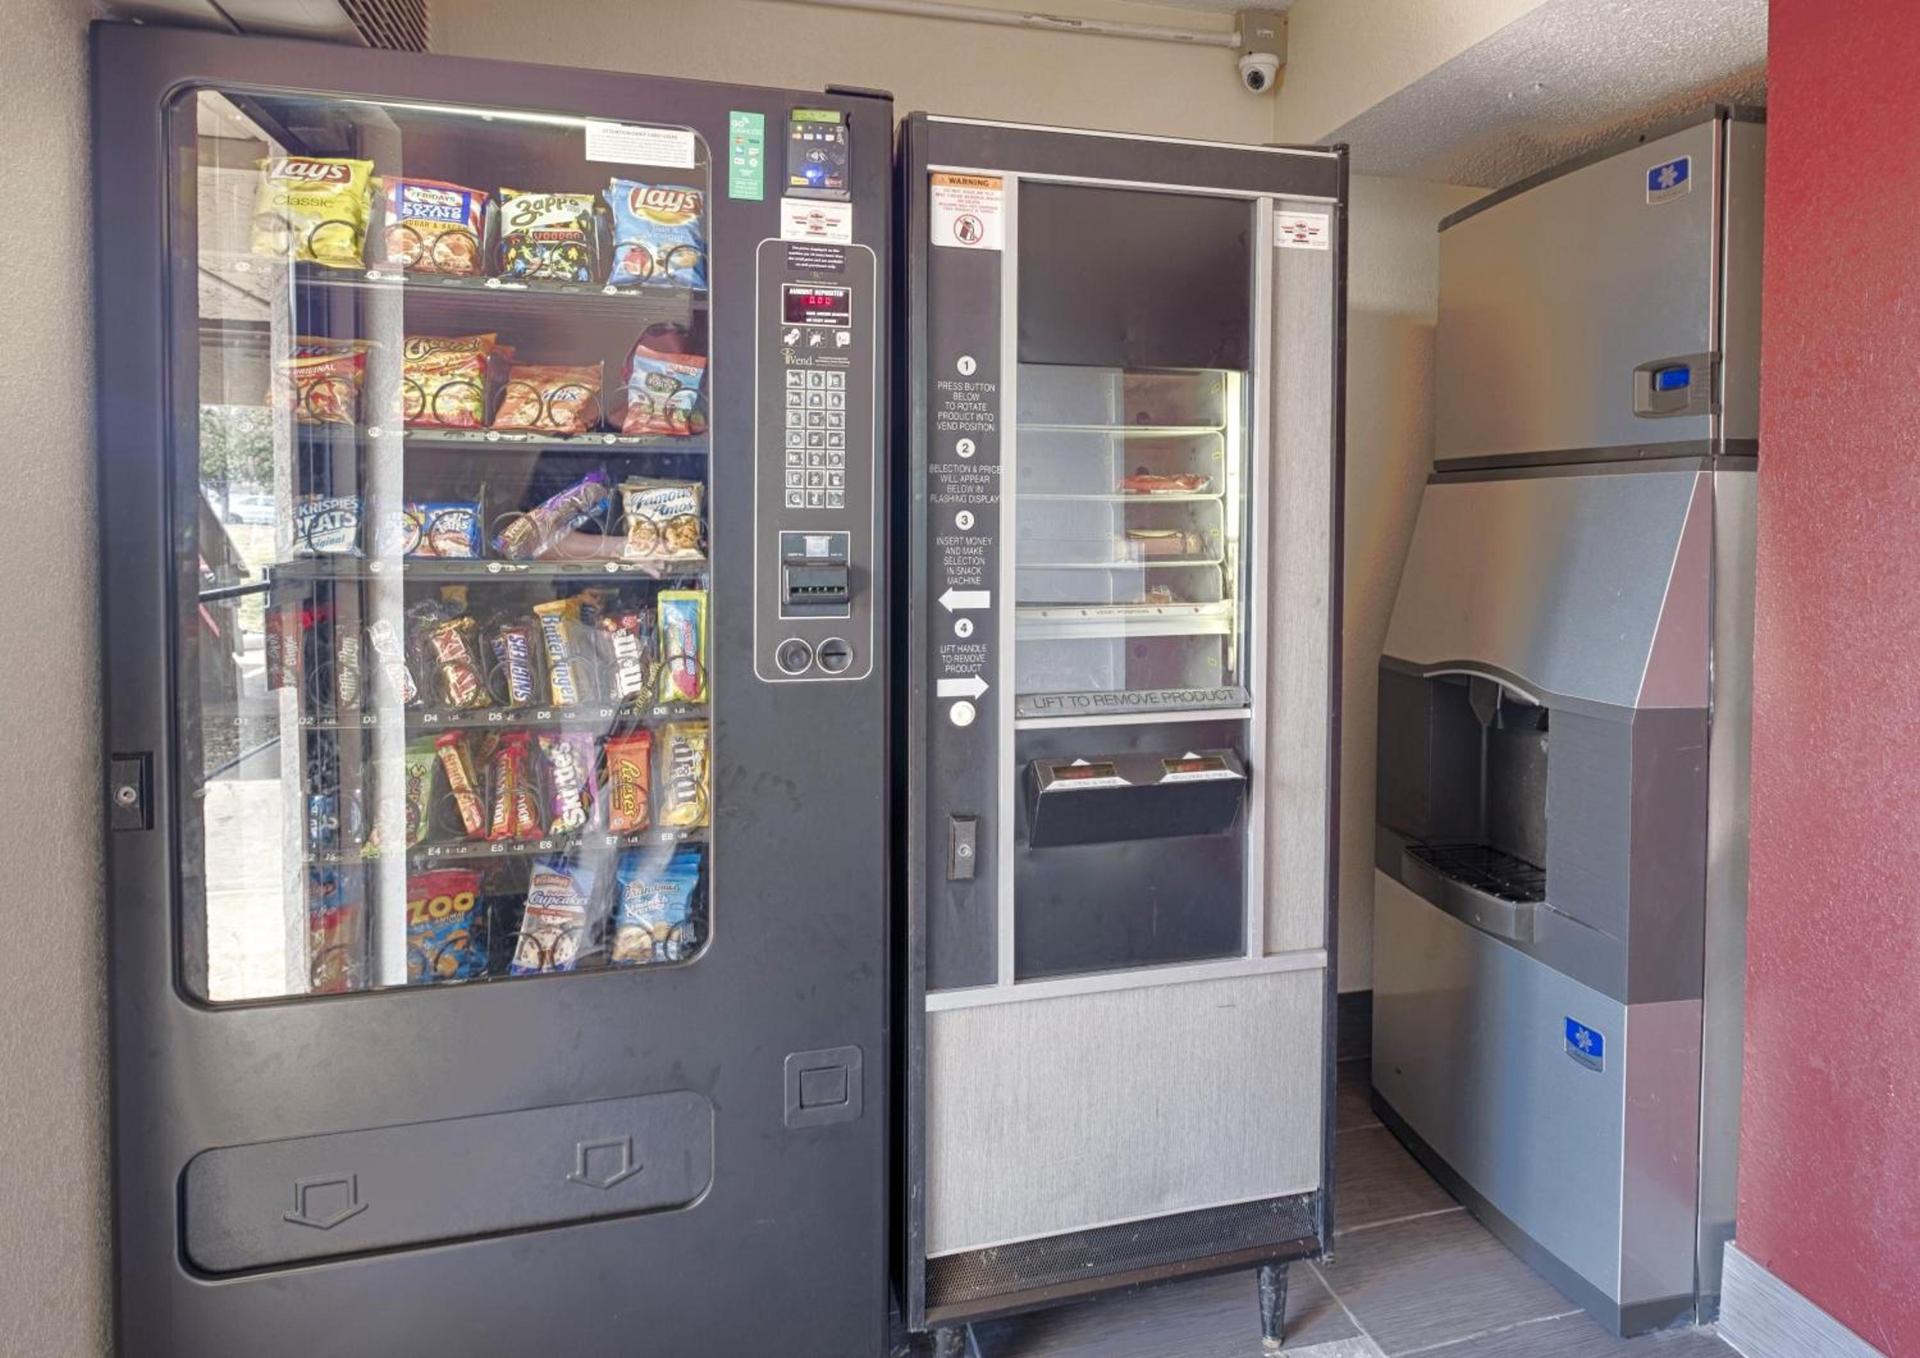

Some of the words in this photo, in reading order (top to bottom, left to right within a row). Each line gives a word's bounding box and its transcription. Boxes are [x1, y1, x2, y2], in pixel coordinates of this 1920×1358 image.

[947, 177, 990, 187] WARNING
[273, 194, 333, 208] Classic
[937, 381, 963, 391] PRESS
[964, 382, 996, 393] BUTTON
[952, 392, 980, 402] BELOW
[945, 401, 956, 411] TO
[957, 402, 987, 412] ROTATE
[937, 411, 975, 422] PRODUCT
[976, 413, 995, 422] INTO
[937, 421, 959, 432] VEND
[959, 422, 995, 432] POSITION
[929, 464, 971, 474] SELECTION
[940, 474, 958, 483] WILL
[959, 475, 991, 484] APPEAR
[946, 484, 974, 494] BELOW
[976, 484, 984, 493] IN
[631, 486, 694, 510] Famous
[929, 494, 967, 504] FLASHING
[968, 494, 1000, 504] DISPLAY
[299, 499, 359, 516] KRISPIES
[652, 501, 695, 517] Amos
[936, 537, 964, 546] INSERT
[965, 536, 993, 546] MONEY
[945, 546, 962, 555] AND
[963, 546, 984, 555] MAKE
[943, 556, 986, 566] SELECTION
[946, 566, 955, 576] IN
[956, 566, 982, 576] SNACK
[947, 576, 981, 585] MACHINE
[939, 644, 956, 654] LIFT
[956, 643, 987, 653] HANDLE
[941, 654, 953, 664] TO
[953, 654, 986, 663] REMOVE
[507, 633, 532, 703] SNICKERS
[945, 663, 982, 673] PRODUCT
[1033, 696, 1065, 710] LIFT
[1067, 695, 1090, 709] TO
[1092, 692, 1161, 707] REMOVE
[1162, 688, 1235, 704] PRODUCT
[424, 713, 438, 723] D4
[488, 712, 503, 722] D5
[537, 711, 551, 720] D6
[599, 709, 613, 718] D7
[606, 836, 619, 845] E7
[428, 847, 441, 856] E4
[528, 889, 589, 908] Cupcakes
[406, 891, 476, 926] ZOO
